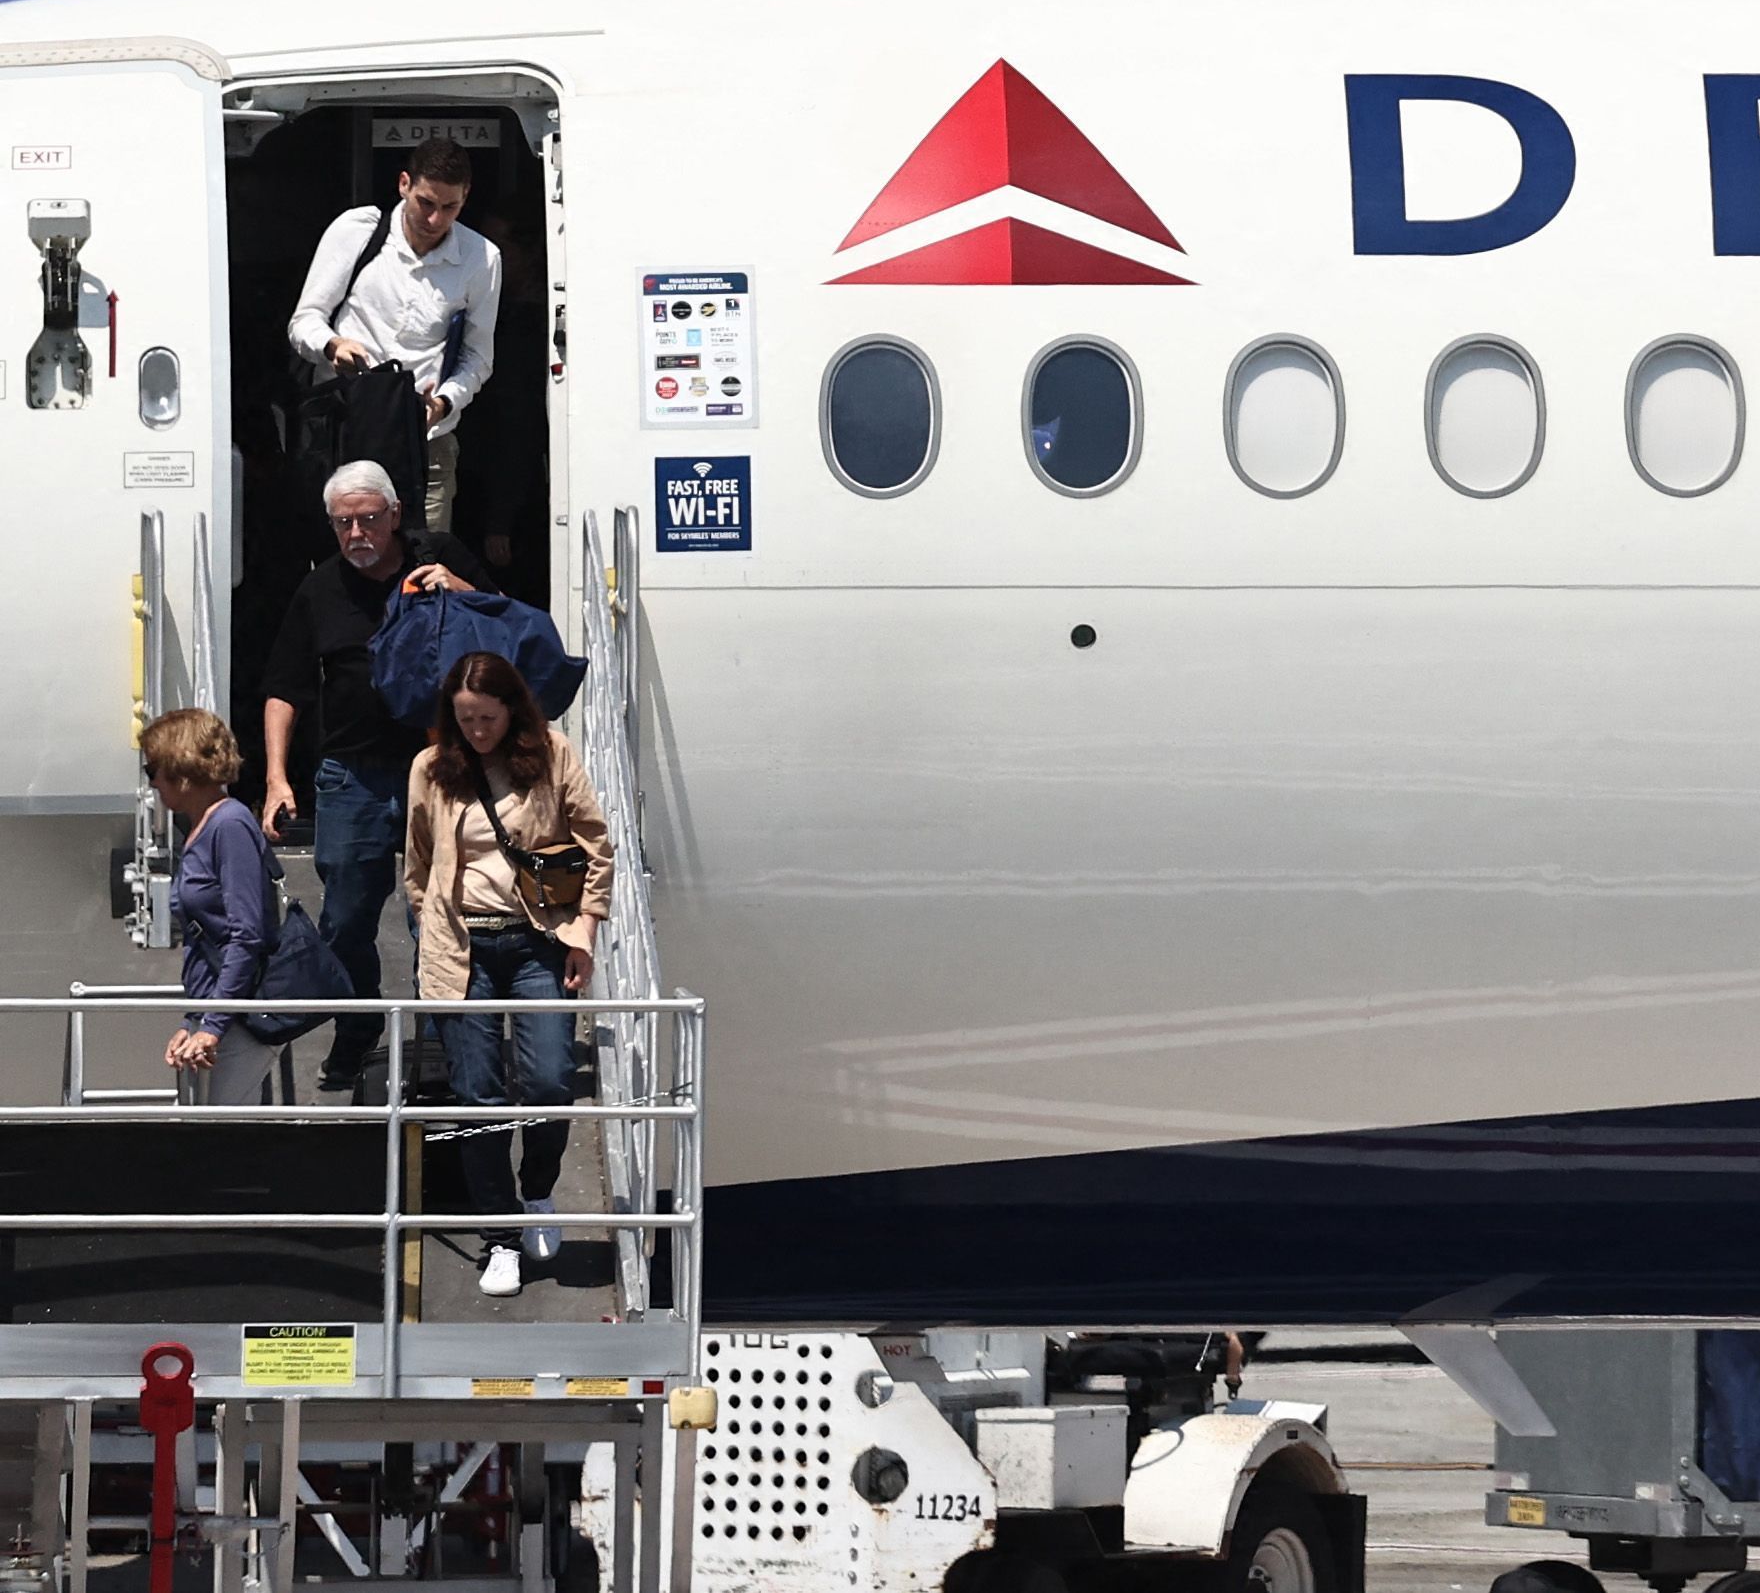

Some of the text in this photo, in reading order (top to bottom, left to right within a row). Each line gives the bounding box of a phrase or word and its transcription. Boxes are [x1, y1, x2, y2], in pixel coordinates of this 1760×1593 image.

[410, 126, 490, 141] DELTA
[20, 151, 65, 164] EXIT
[667, 479, 739, 496] FAST, FREE
[668, 496, 740, 526] WI-FI
[667, 532, 680, 540] FOR
[269, 1326, 327, 1337] CAUTION!
[883, 1344, 912, 1356] HOT
[915, 1494, 982, 1522] 11234
